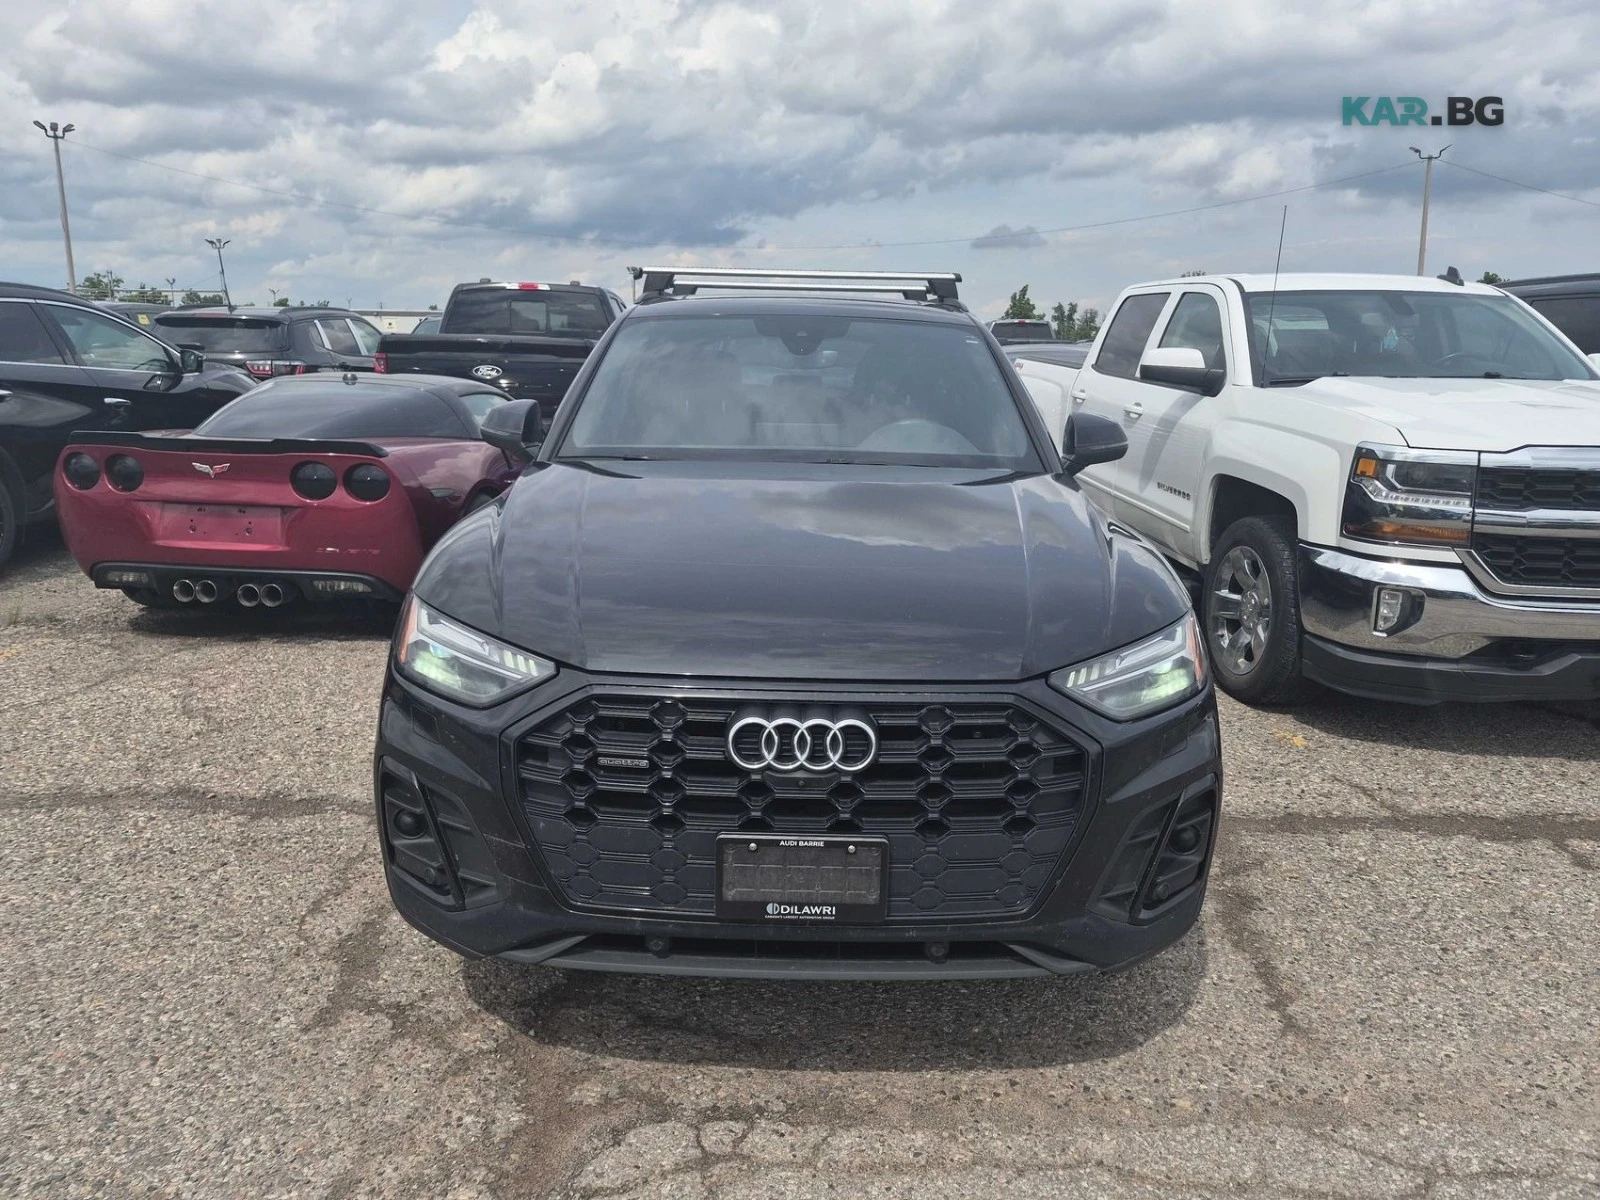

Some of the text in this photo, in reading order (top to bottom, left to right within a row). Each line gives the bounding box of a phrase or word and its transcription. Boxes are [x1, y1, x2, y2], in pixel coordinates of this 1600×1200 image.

[476, 366, 499, 377] Ford
[1157, 482, 1191, 501] SILVERADO
[599, 759, 647, 767] quattro
[780, 905, 836, 915] DILAWRI
